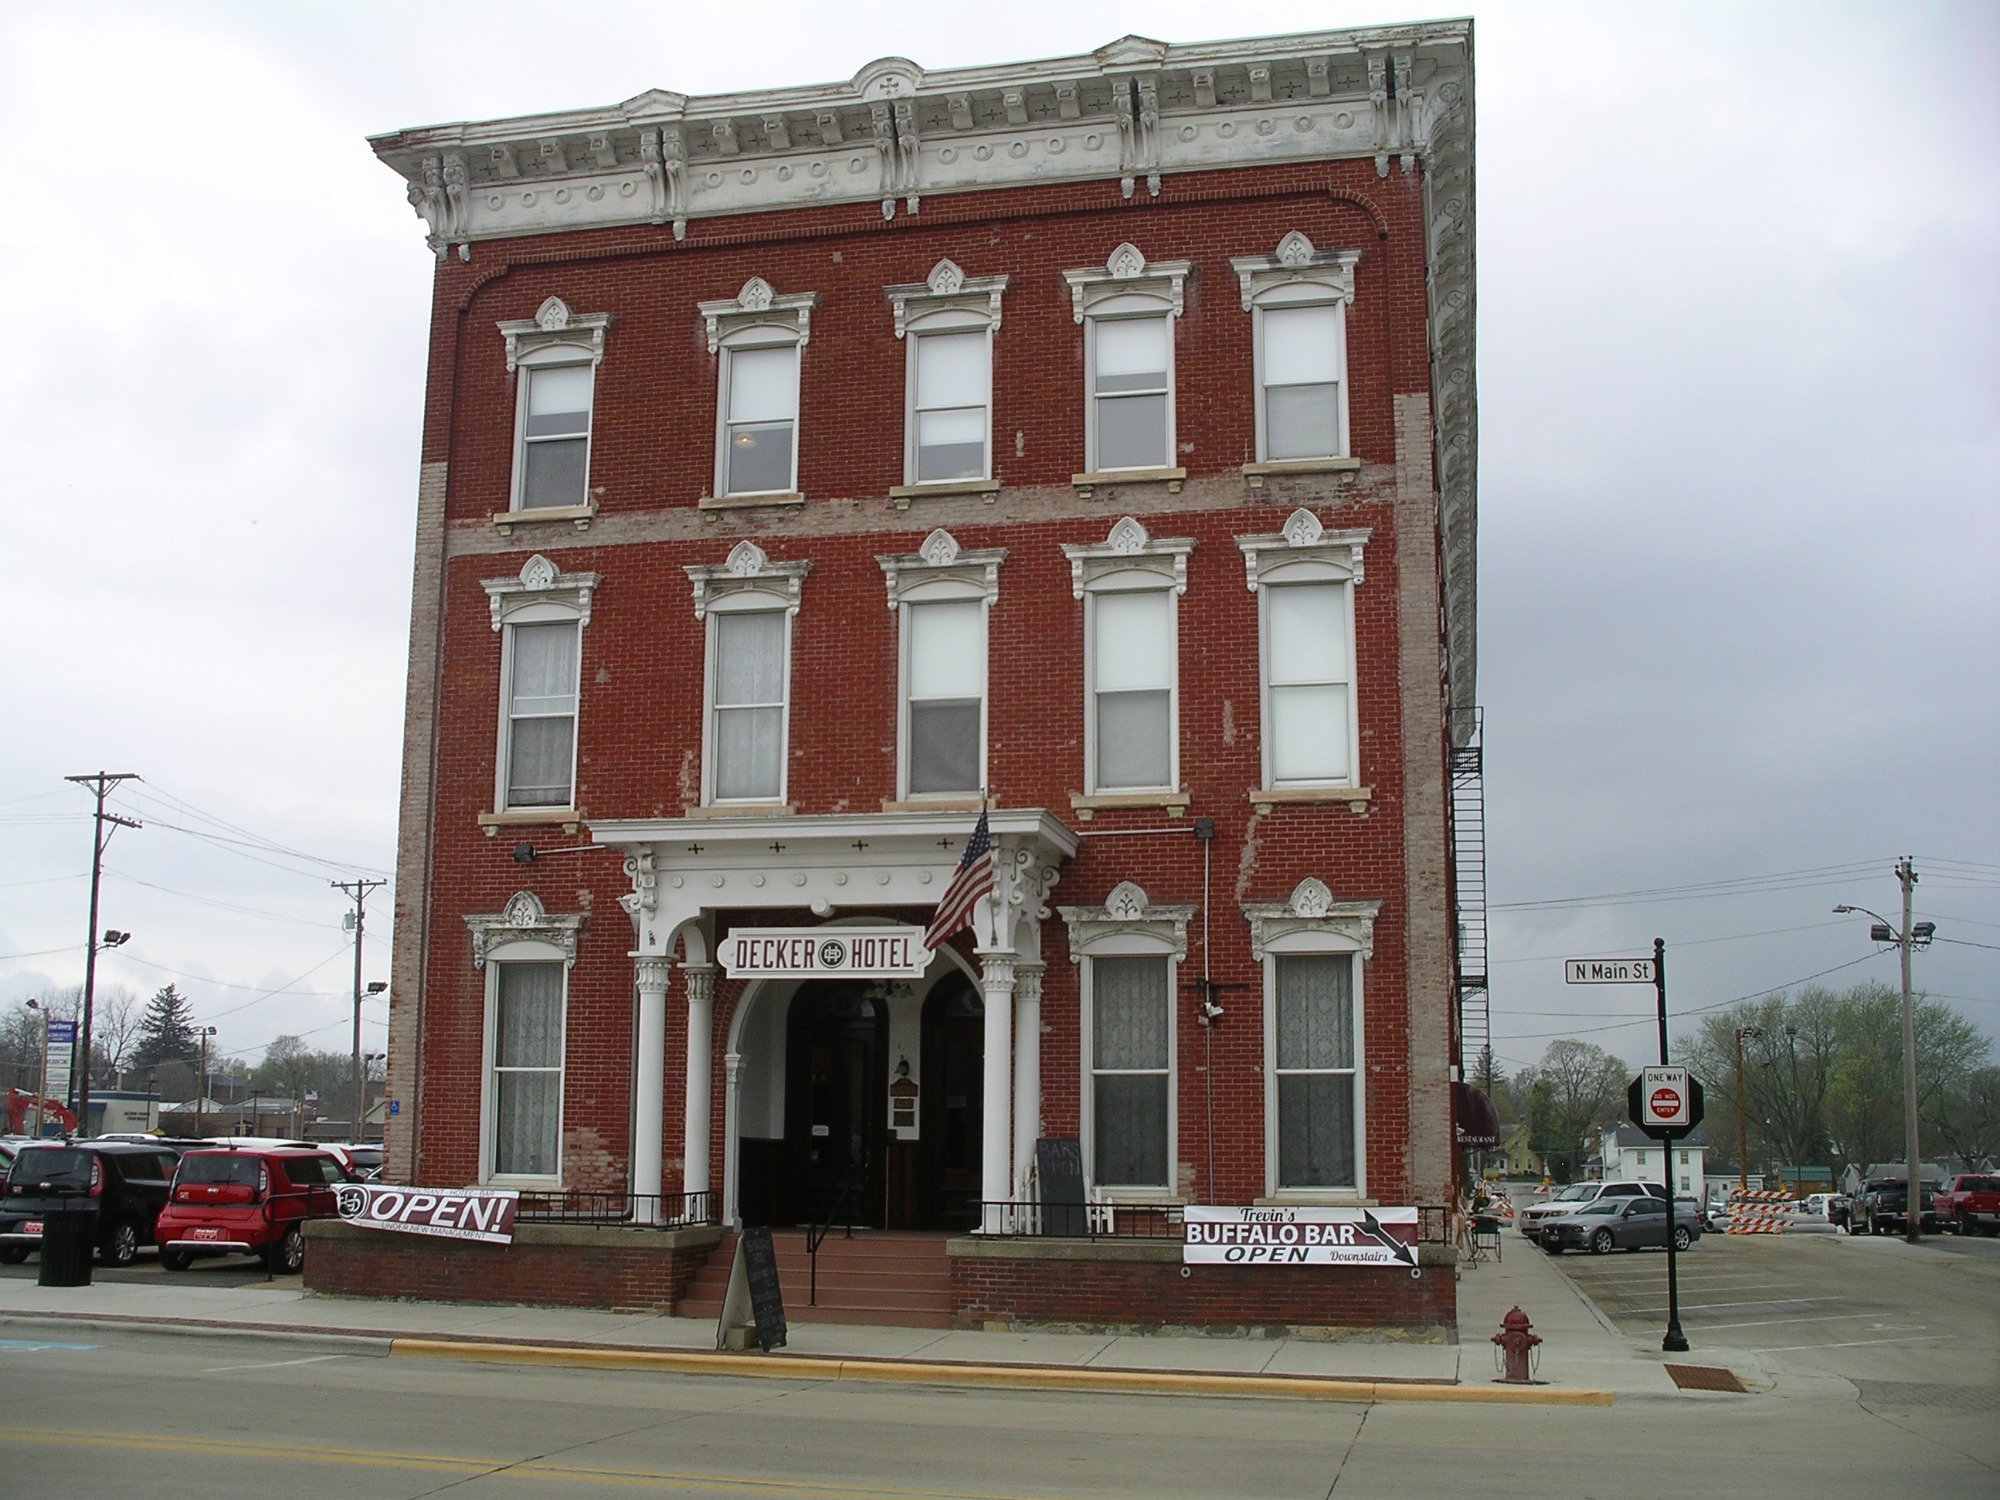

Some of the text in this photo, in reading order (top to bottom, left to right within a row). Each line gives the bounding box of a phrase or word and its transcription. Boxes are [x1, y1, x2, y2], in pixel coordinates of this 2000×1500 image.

[735, 939, 816, 969] DECKER
[851, 938, 914, 968] HOTEL
[1576, 963, 1649, 980] N Main St
[1648, 1073, 1683, 1082] ONE WAY
[370, 1192, 510, 1232] OPEN!
[1239, 1207, 1296, 1223] Trevin's
[381, 1222, 487, 1239] UNDER NEW MANAGEMENT
[1186, 1223, 1356, 1244] BUFFALO BAR
[1224, 1247, 1310, 1262] OPEN
[1329, 1250, 1388, 1264] Downstairs
